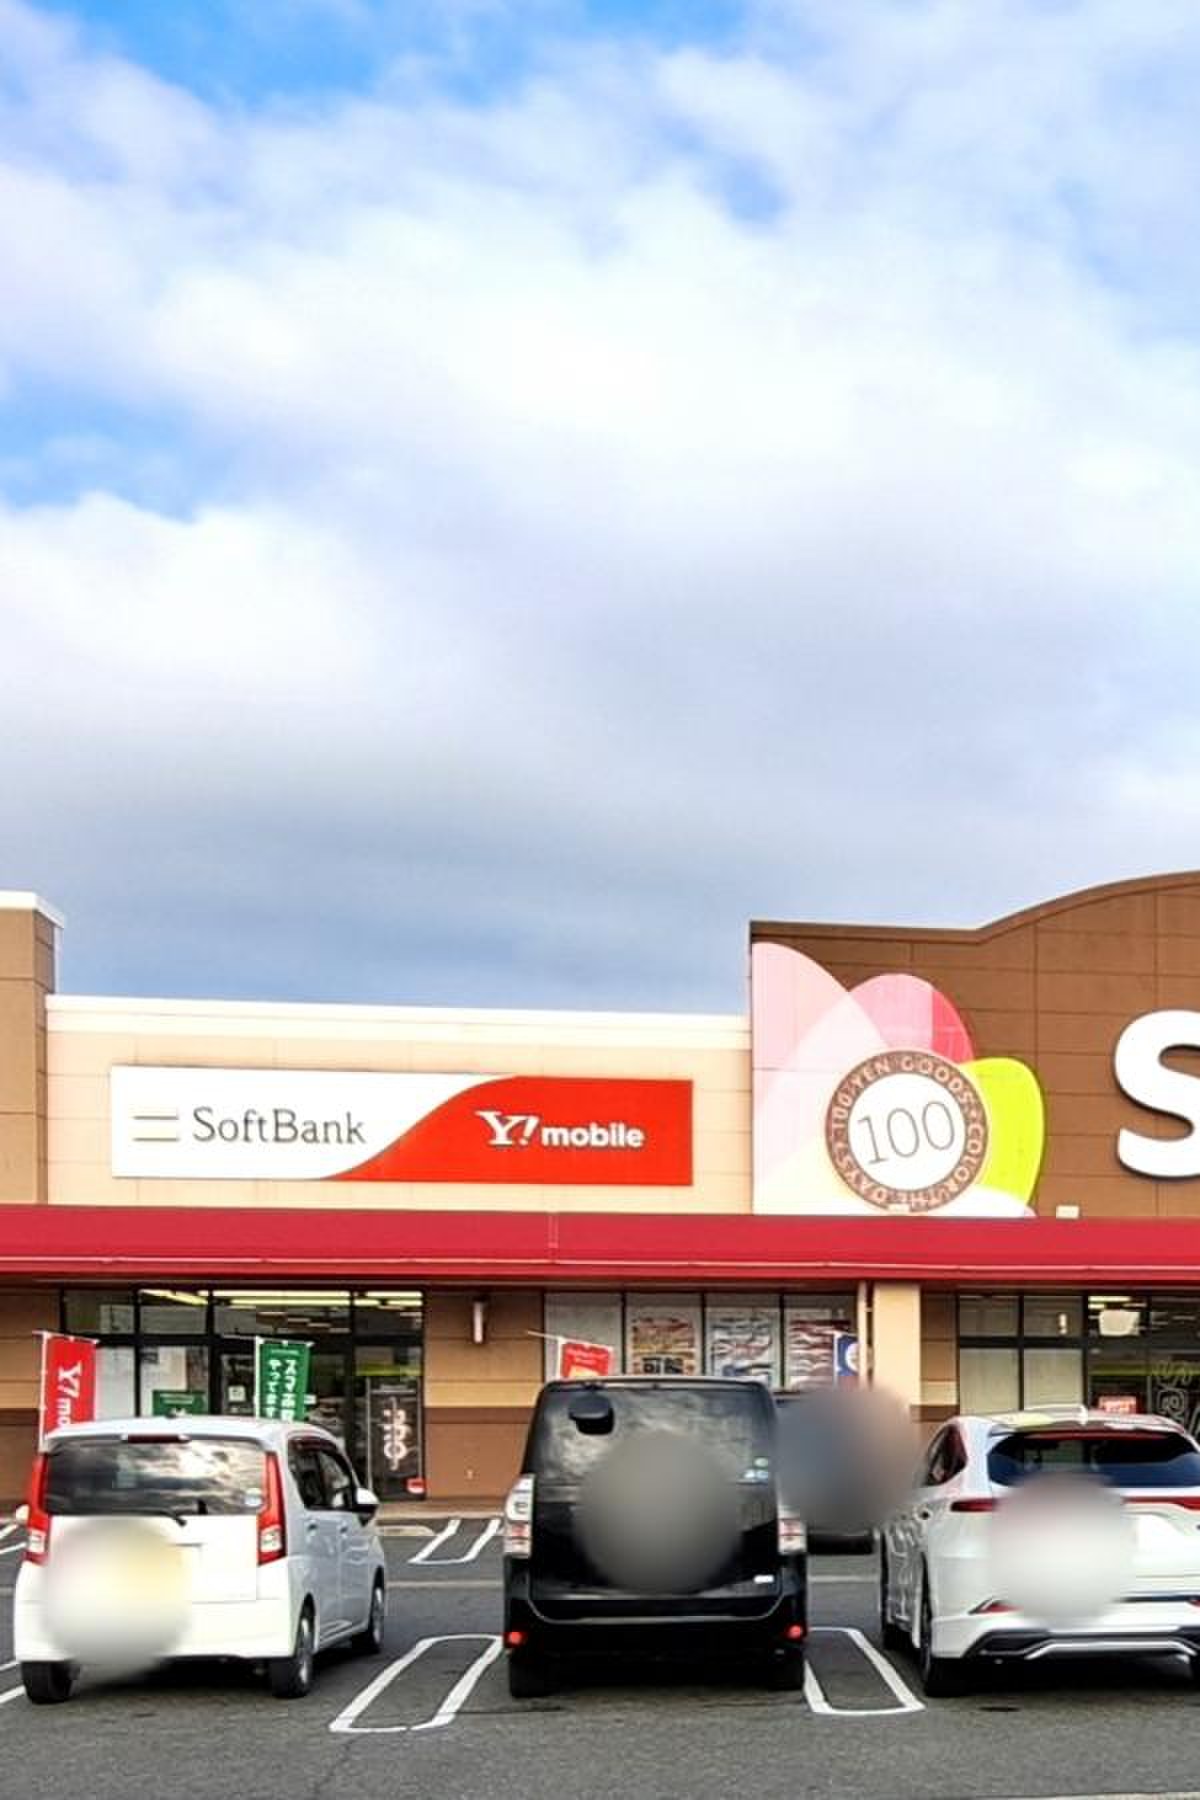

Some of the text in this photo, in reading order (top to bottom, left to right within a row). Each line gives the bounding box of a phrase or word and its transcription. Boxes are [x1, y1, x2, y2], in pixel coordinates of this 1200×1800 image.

[902, 1057, 975, 1105] GOODS
[193, 1106, 366, 1146] SoftBank
[476, 1110, 645, 1149] Y! mobile
[857, 1100, 956, 1165] 100
